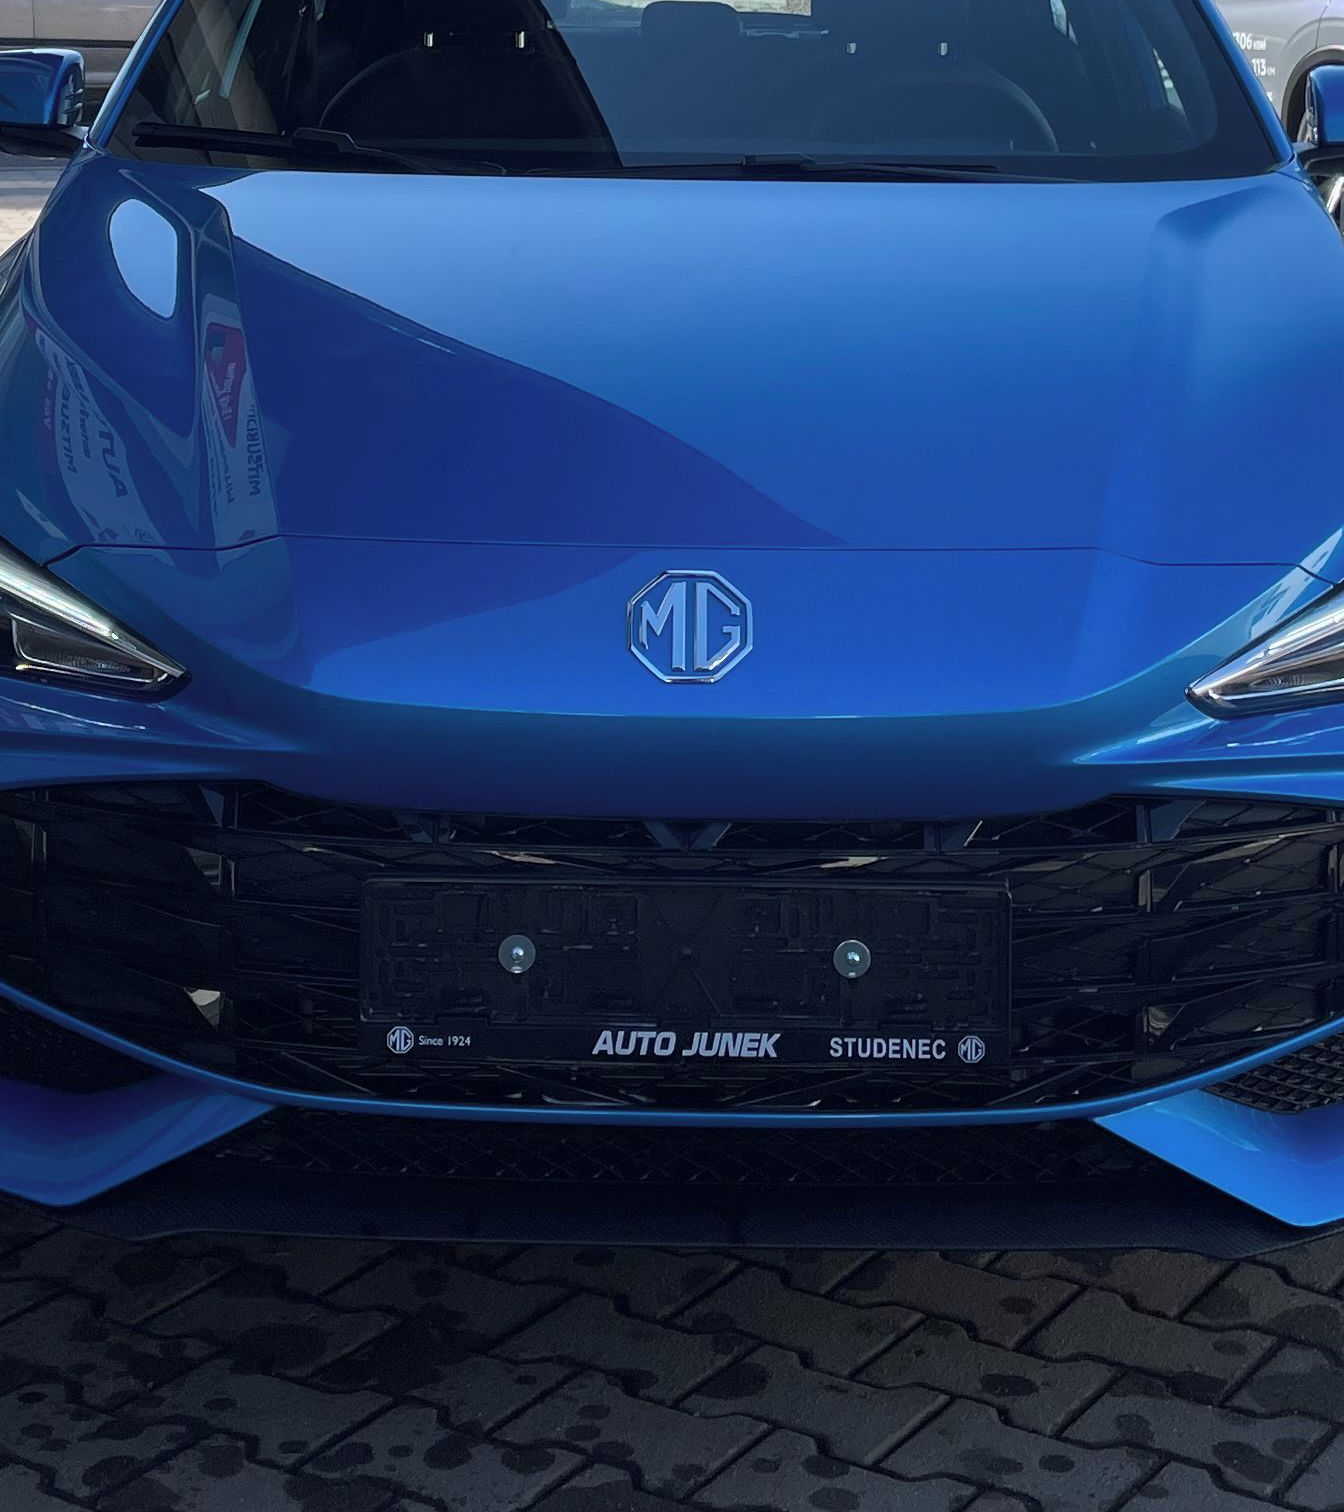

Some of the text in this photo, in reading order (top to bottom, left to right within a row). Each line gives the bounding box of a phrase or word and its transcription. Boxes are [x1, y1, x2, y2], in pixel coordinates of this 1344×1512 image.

[639, 580, 741, 672] MG
[417, 1034, 444, 1047] Since
[447, 1034, 472, 1047] 1924
[591, 1029, 677, 1058] AUTO
[682, 1031, 780, 1060] JUNEK
[828, 1035, 947, 1061] STUDENEC
